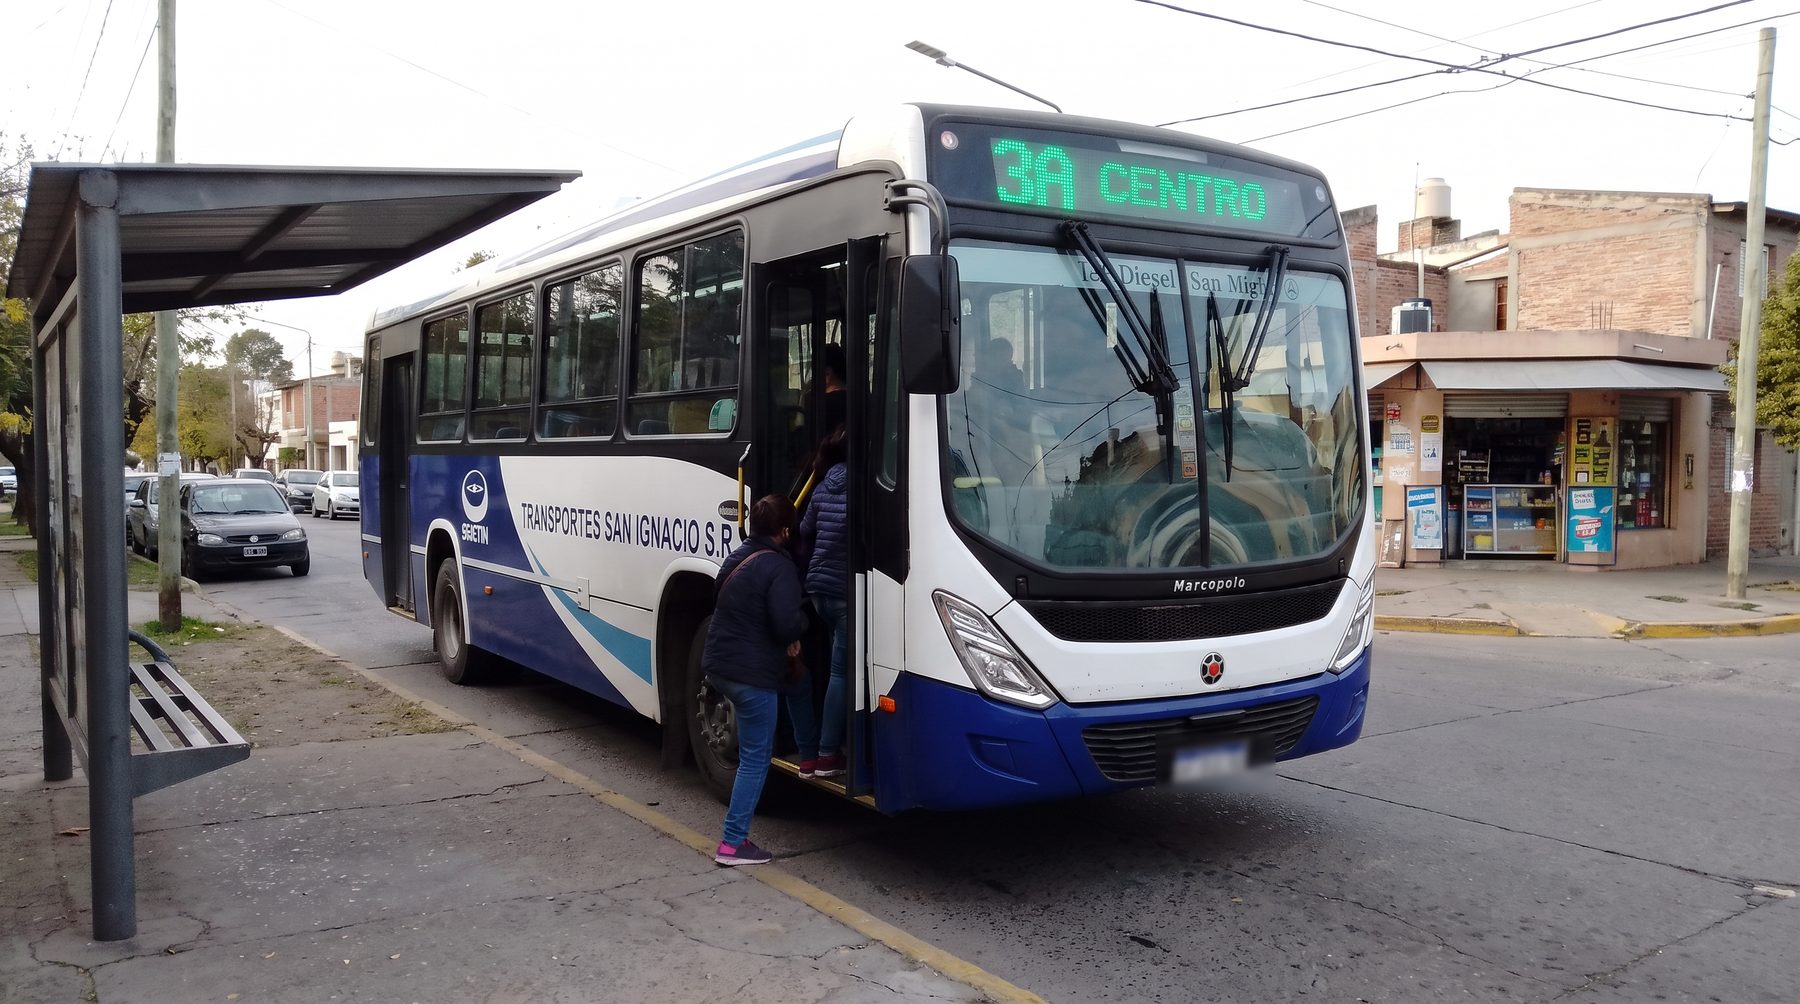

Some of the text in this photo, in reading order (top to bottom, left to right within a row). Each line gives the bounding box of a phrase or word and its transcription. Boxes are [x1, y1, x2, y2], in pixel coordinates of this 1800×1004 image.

[994, 139, 1266, 220] 3A CENTRO
[1118, 264, 1177, 289] Diesel
[1190, 271, 1222, 292] San
[521, 502, 601, 540] TRANSPORTES
[604, 511, 631, 545] SAN
[636, 514, 699, 555] IGNACIO
[1173, 576, 1245, 592] Marcopolo
